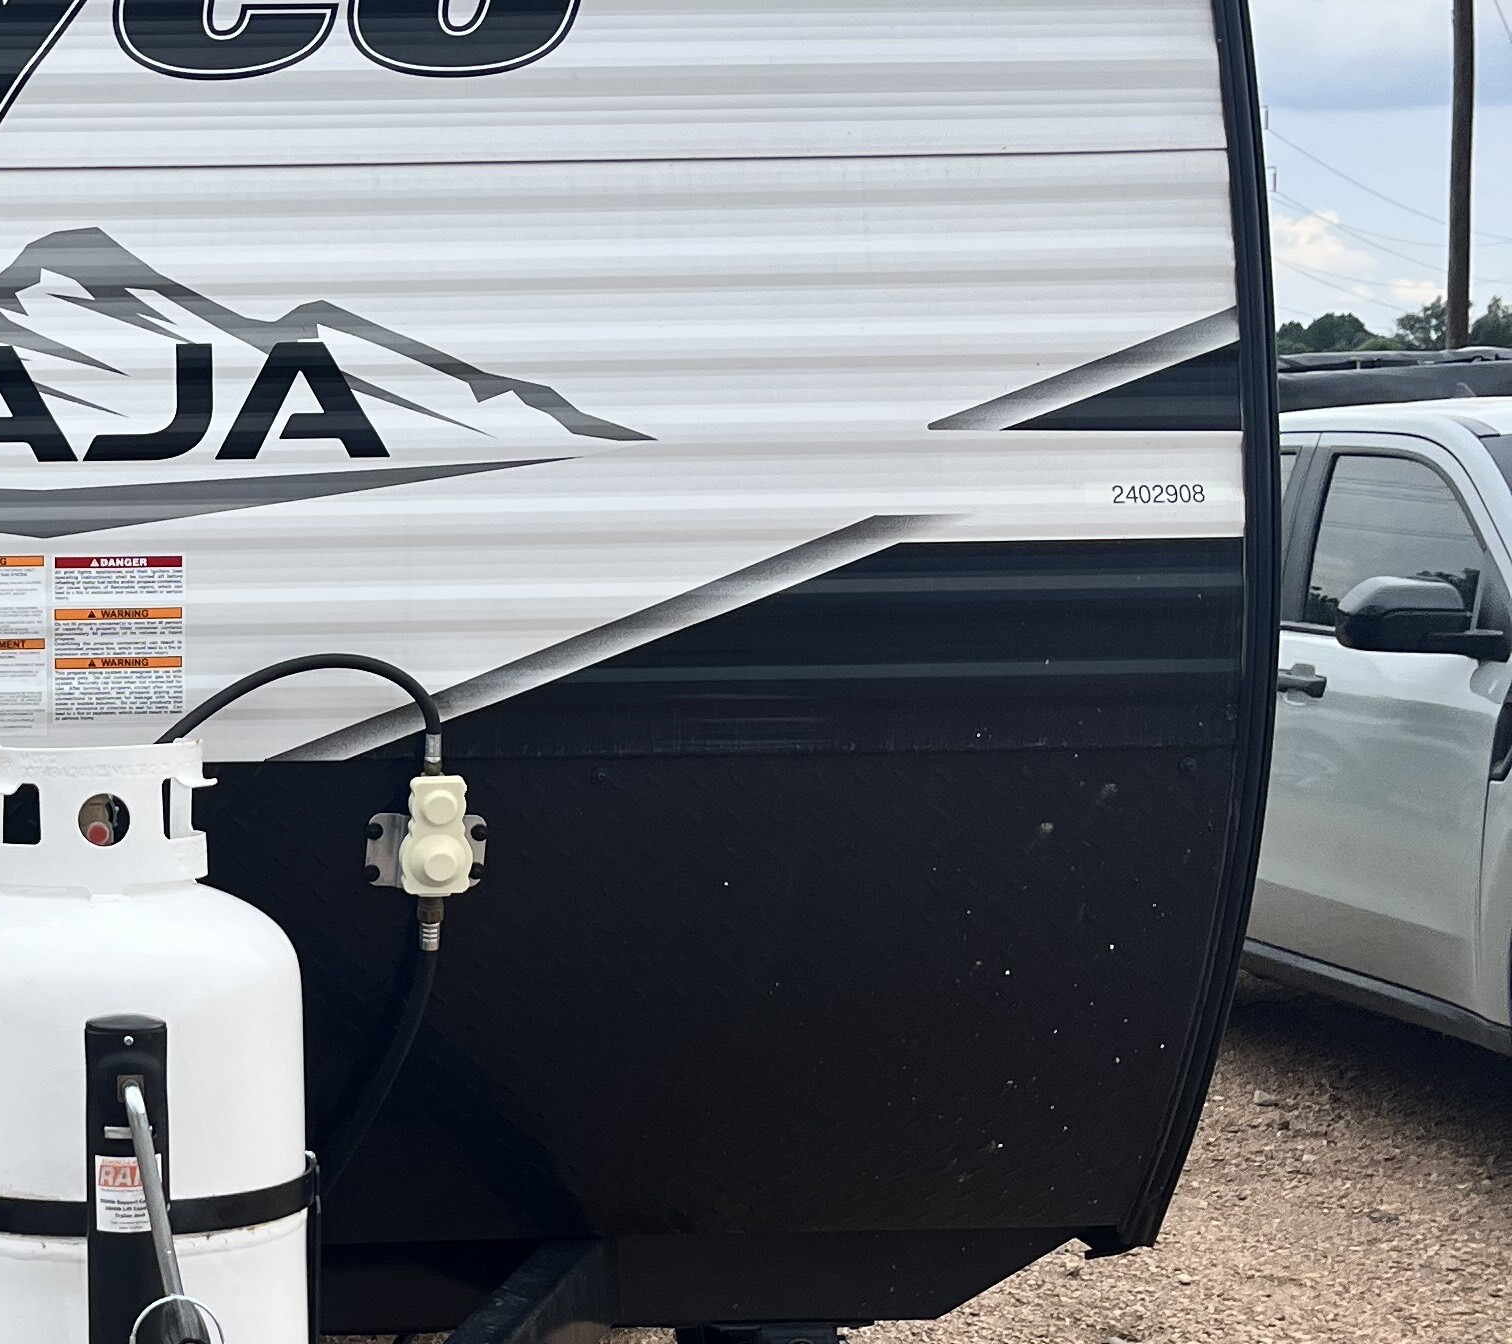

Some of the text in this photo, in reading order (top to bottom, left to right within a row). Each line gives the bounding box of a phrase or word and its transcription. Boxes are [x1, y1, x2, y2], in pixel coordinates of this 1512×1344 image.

[1112, 484, 1205, 503] 2402908
[100, 557, 147, 567] DANGER
[100, 609, 149, 618] WARNING
[100, 658, 149, 667] WARNING
